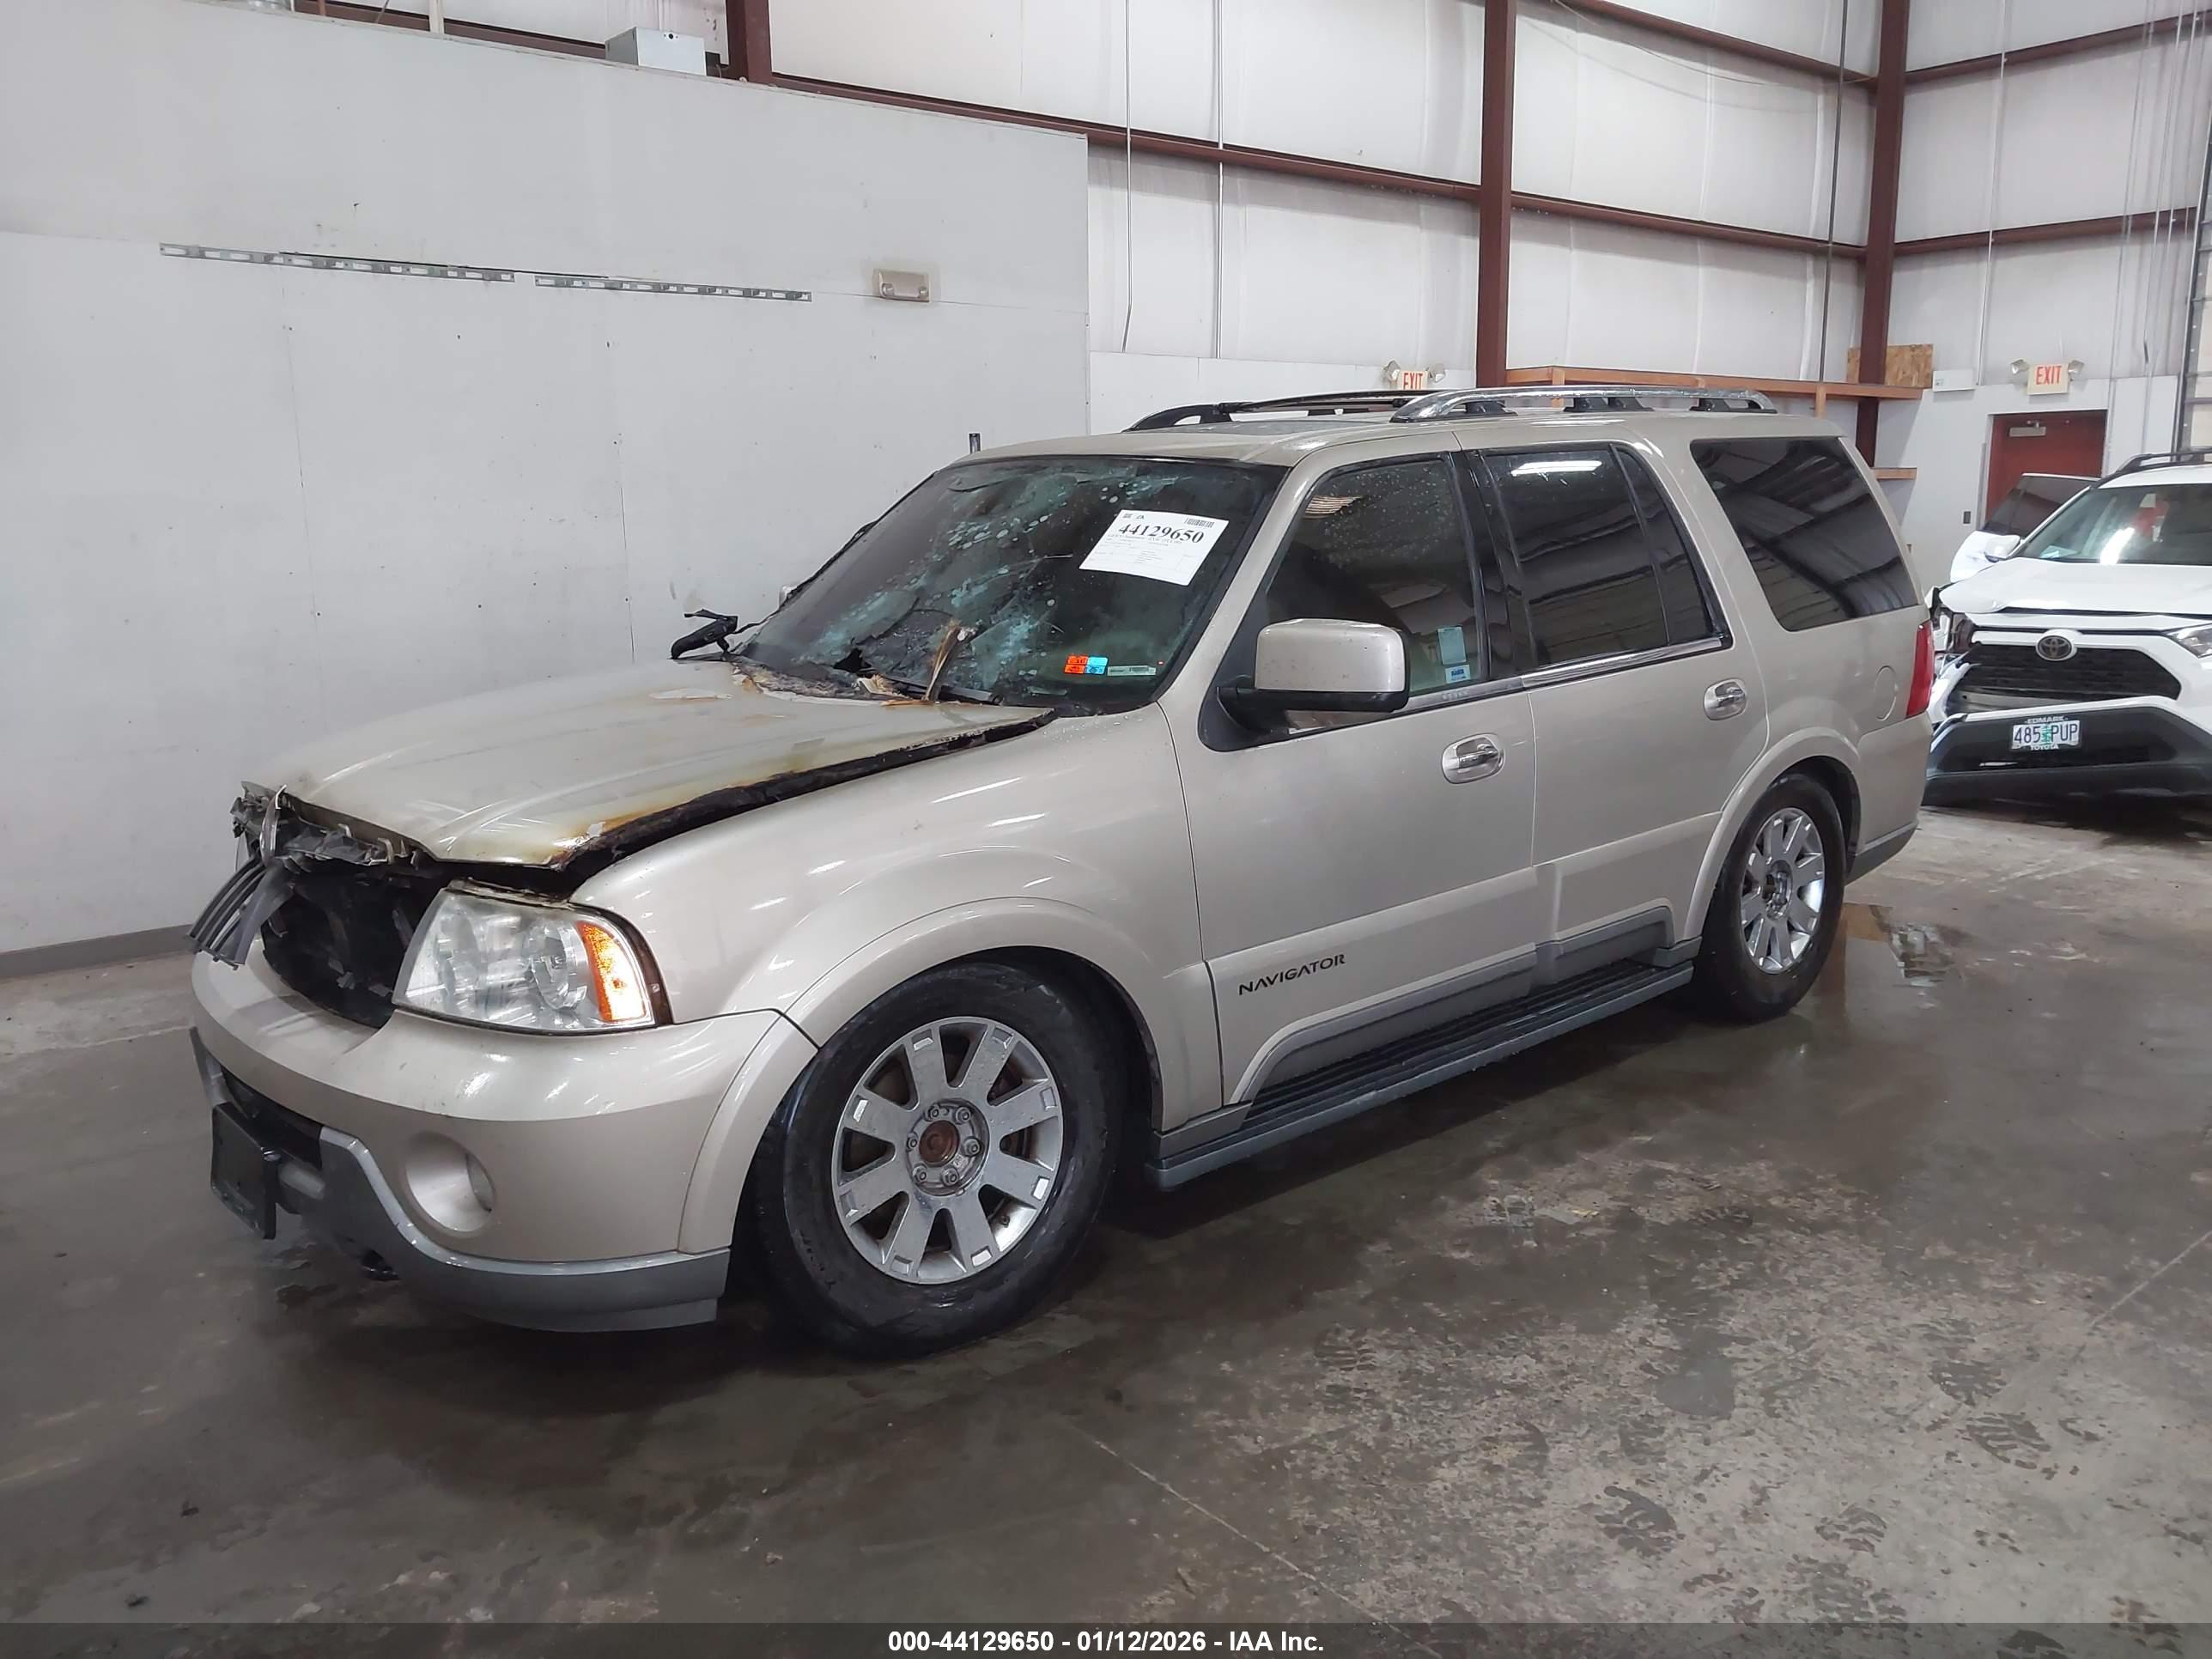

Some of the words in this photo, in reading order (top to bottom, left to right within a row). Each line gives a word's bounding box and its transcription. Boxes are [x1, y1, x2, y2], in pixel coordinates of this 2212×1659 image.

[1403, 373, 1423, 390] EXIT
[2036, 365, 2062, 385] EXIT
[1119, 523, 1205, 544] 44129650
[2014, 726, 2041, 744] 485
[2051, 723, 2078, 743] PUP
[1239, 954, 1346, 995] NAVIGATOR
